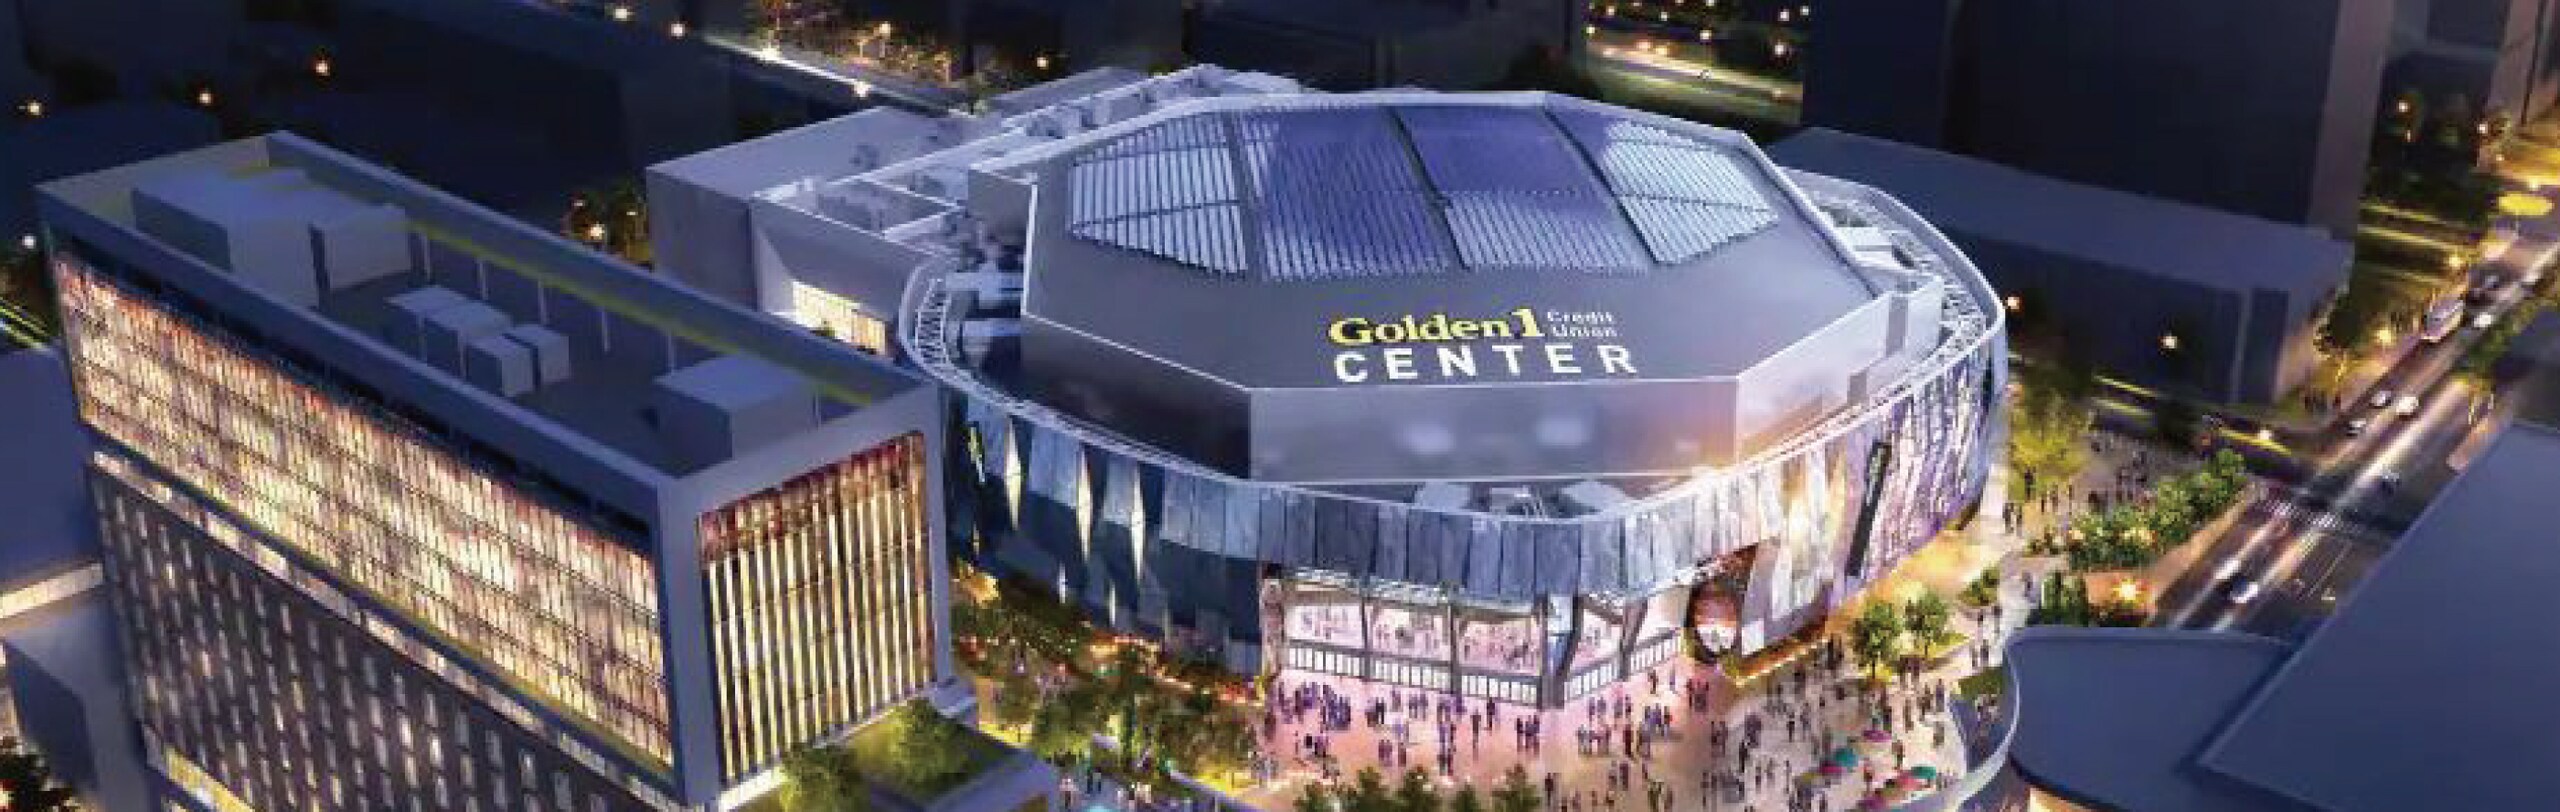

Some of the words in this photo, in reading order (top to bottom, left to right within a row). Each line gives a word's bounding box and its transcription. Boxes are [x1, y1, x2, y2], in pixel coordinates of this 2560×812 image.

[1547, 310, 1615, 323] Credit
[1551, 324, 1618, 337] Union
[1334, 344, 1637, 382] CENTER
